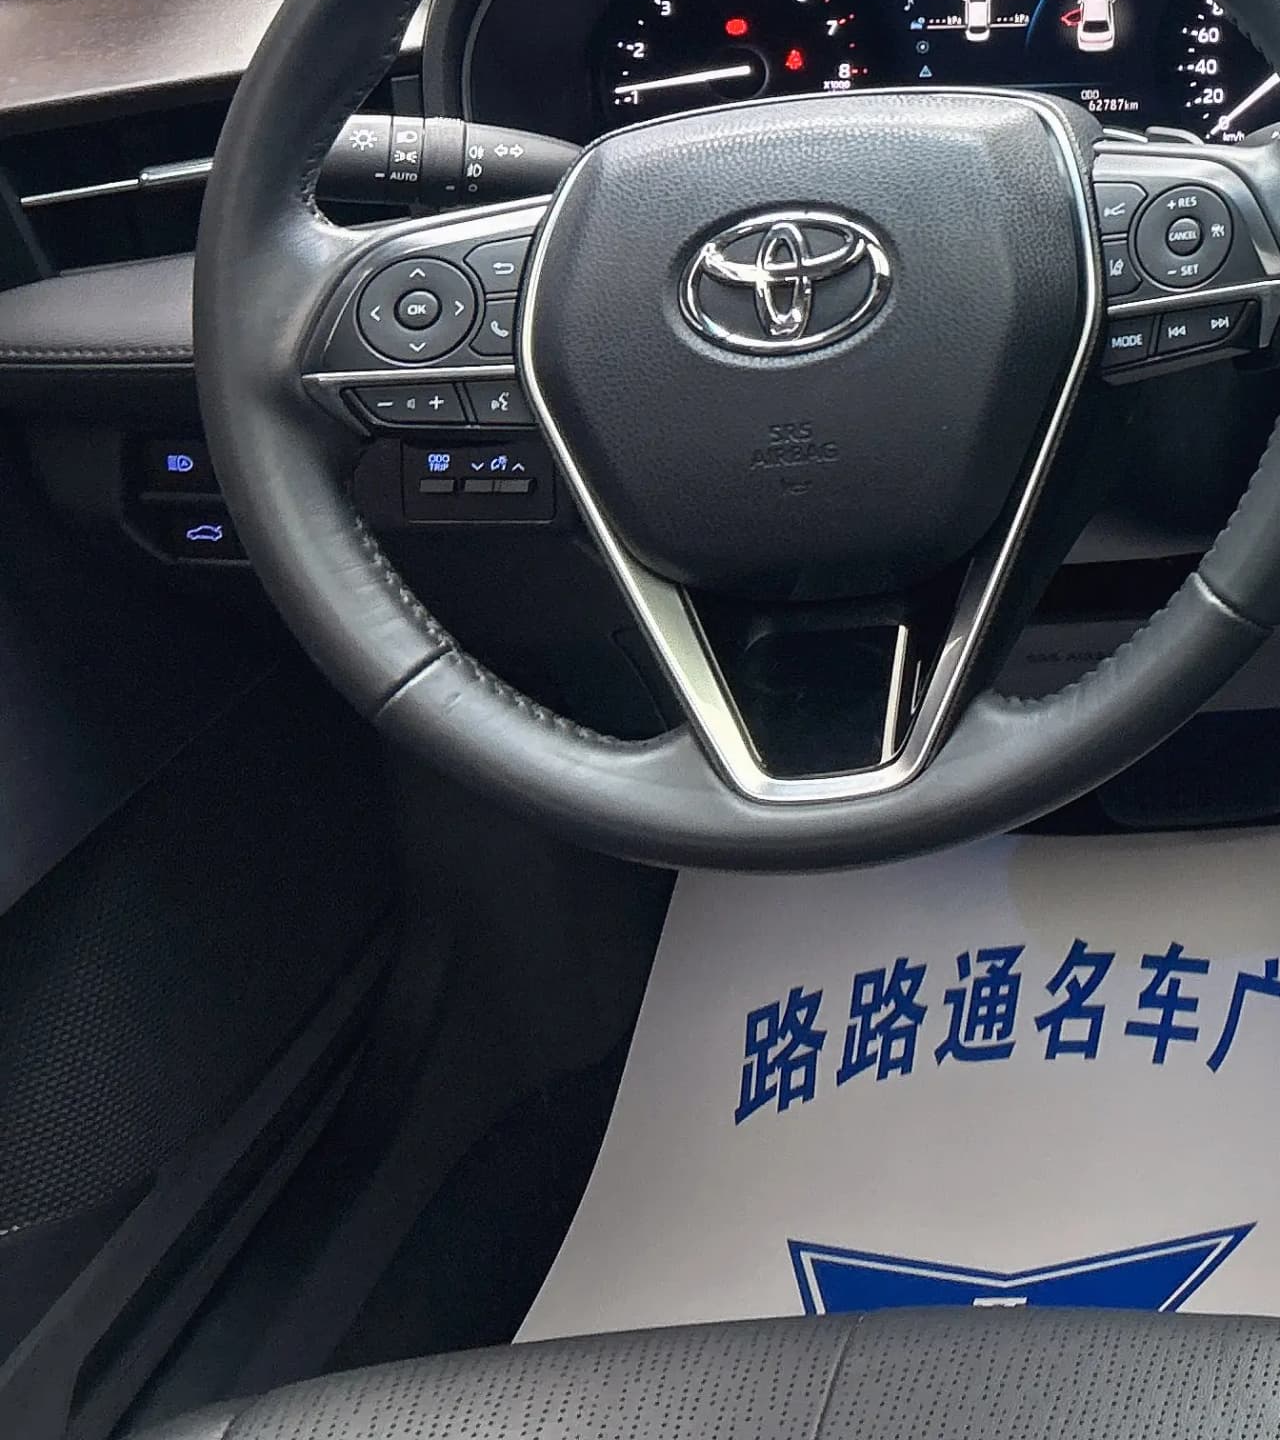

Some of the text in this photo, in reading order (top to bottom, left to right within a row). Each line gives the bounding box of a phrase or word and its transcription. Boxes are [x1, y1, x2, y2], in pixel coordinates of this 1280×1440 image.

[661, 0, 672, 16] 3
[826, 19, 838, 35] 7
[1198, 27, 1220, 43] 60
[633, 42, 645, 58] 2
[838, 63, 850, 78] 8
[1195, 59, 1218, 74] 40
[630, 91, 640, 105] 1
[1203, 88, 1225, 104] 20
[1222, 131, 1246, 143] km/h
[389, 172, 418, 183] AUTO
[1168, 231, 1198, 242] CANCEL
[407, 304, 428, 315] OK
[1111, 333, 1143, 348] MODE
[428, 462, 450, 472] TRIP
